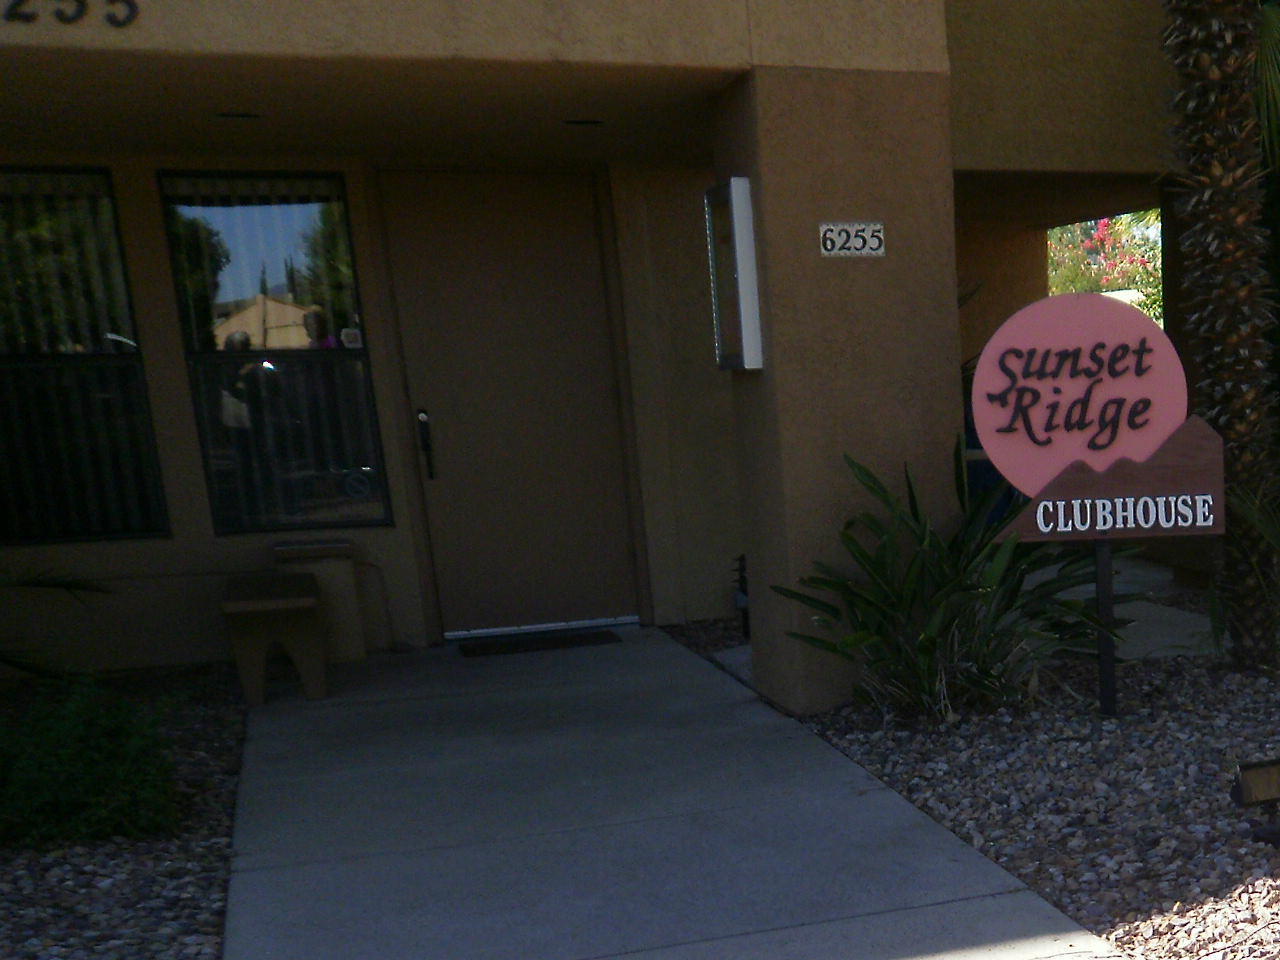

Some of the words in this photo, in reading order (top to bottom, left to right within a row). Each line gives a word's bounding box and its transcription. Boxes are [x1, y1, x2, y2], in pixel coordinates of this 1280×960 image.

[821, 227, 884, 252] 6255
[986, 336, 1153, 408] Sunset
[995, 377, 1153, 450] Ridge
[1036, 494, 1214, 533] CLUBHOUSE
